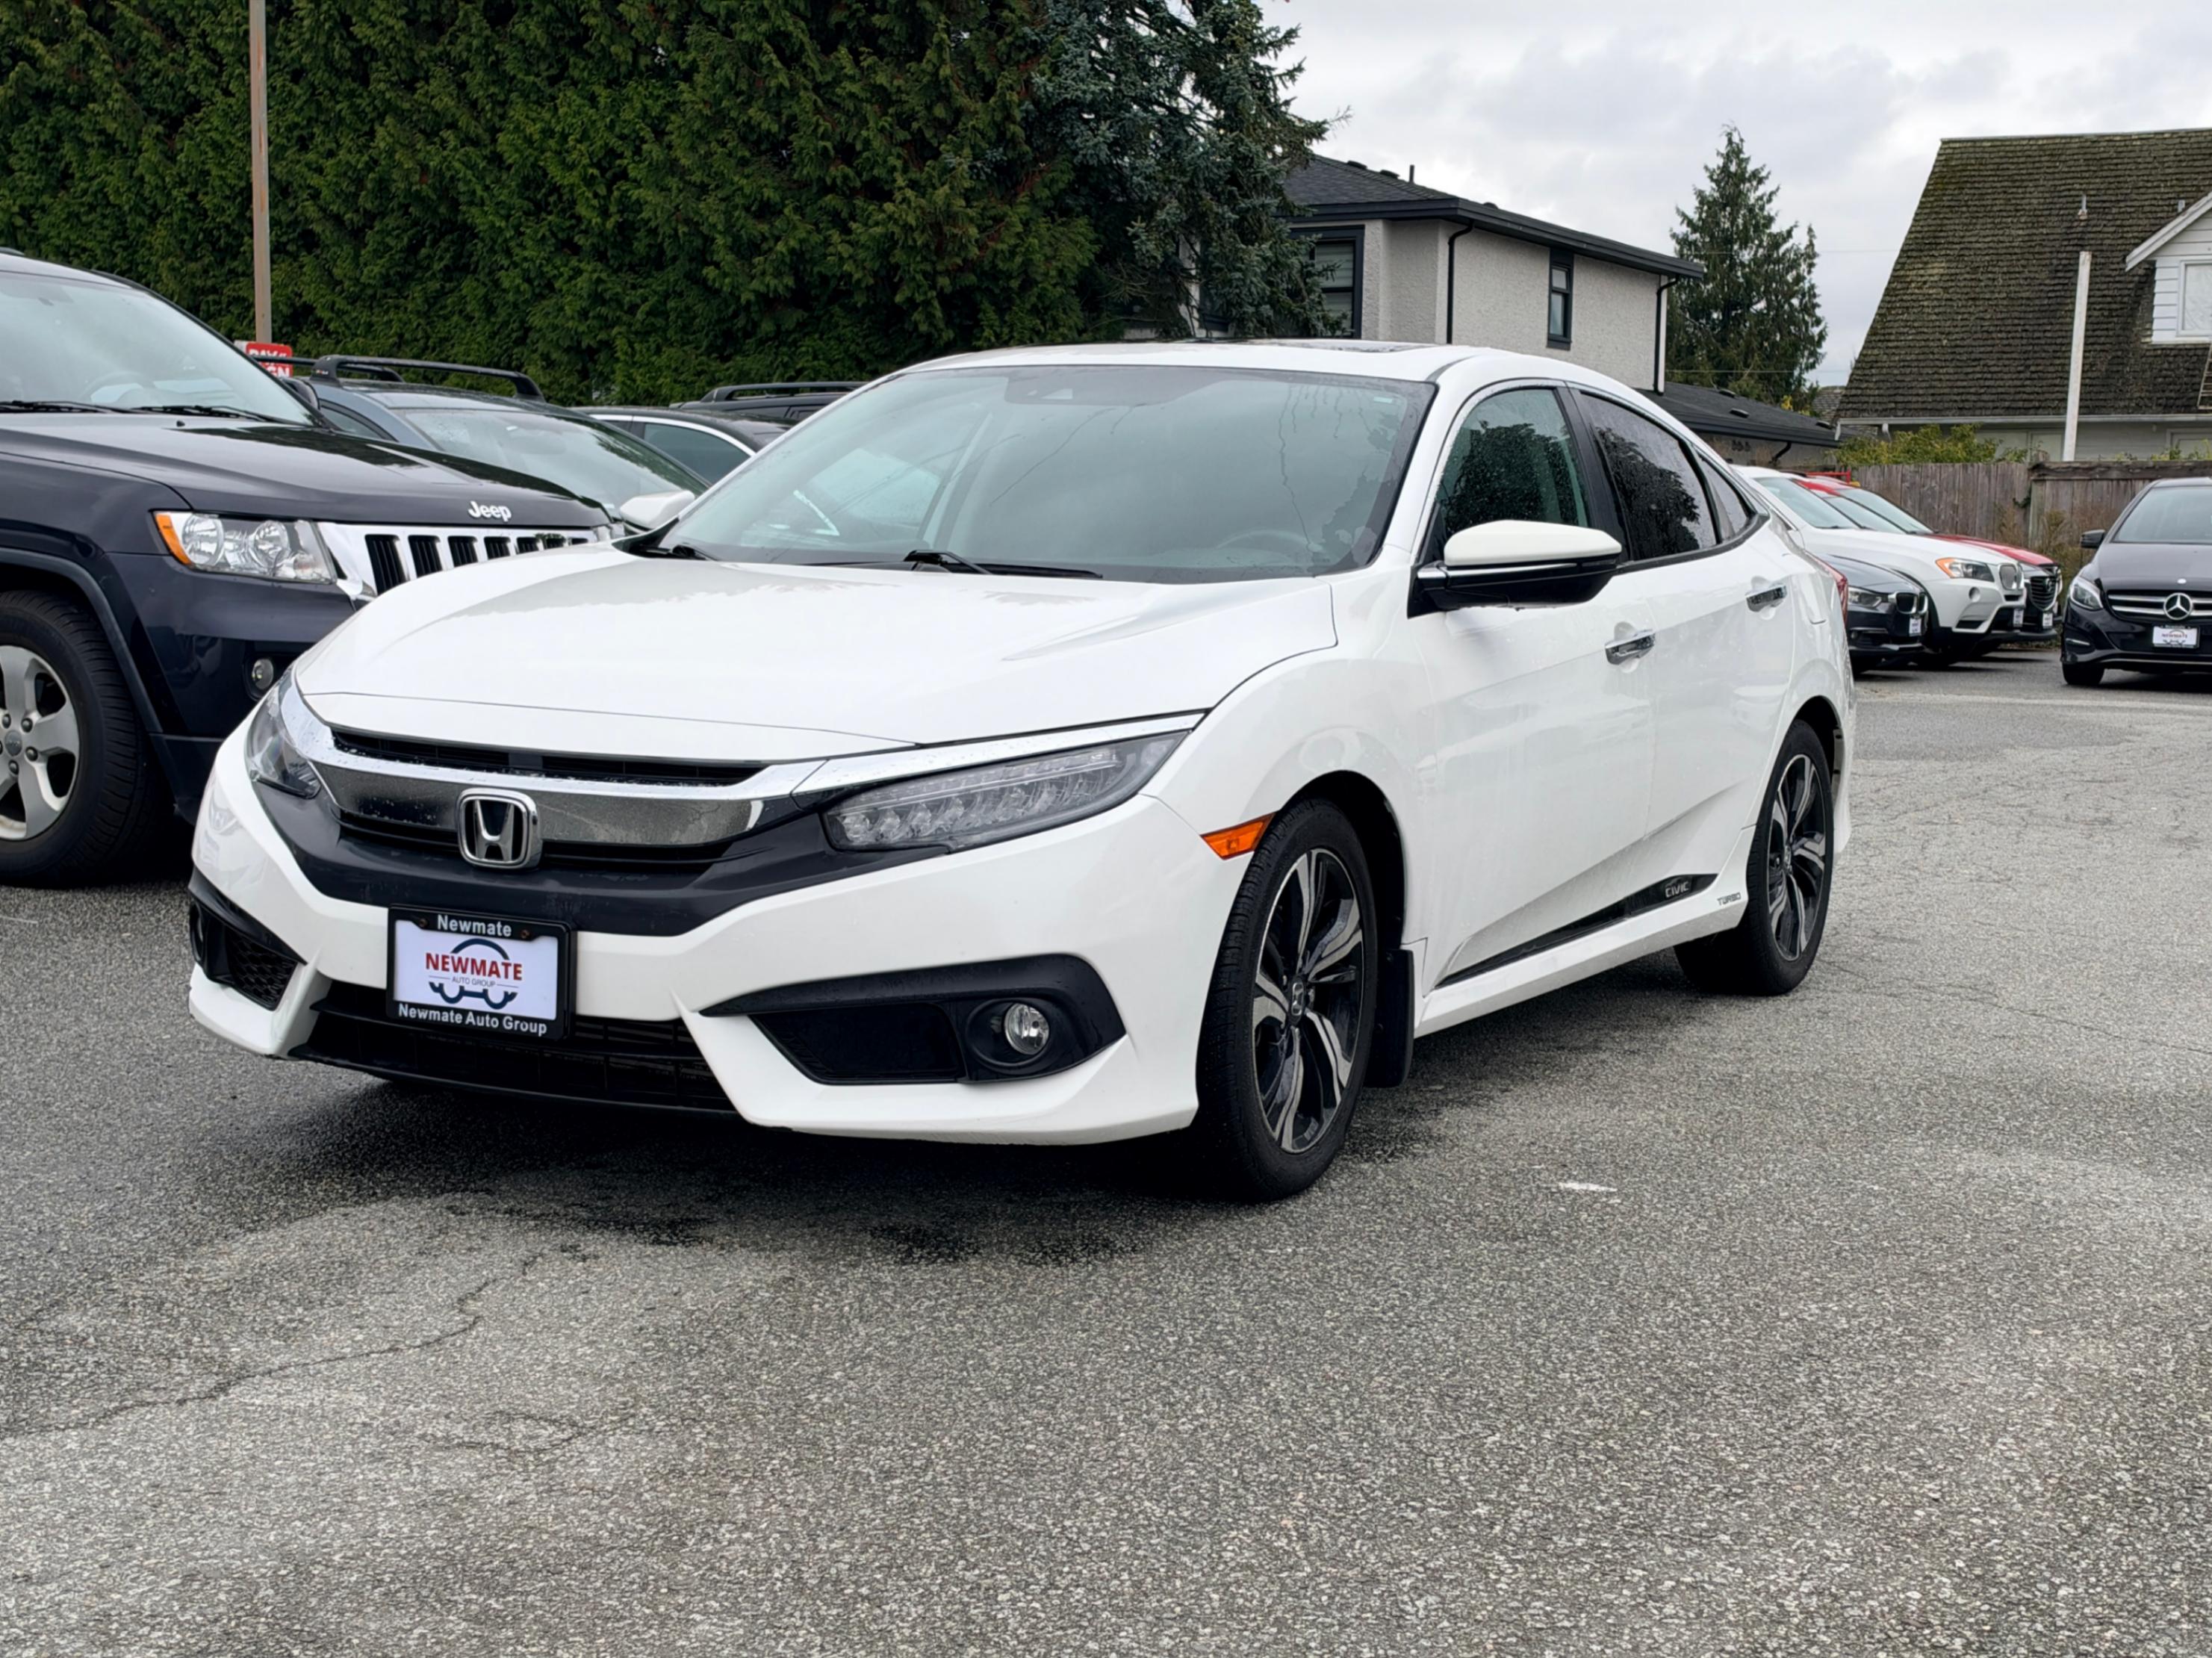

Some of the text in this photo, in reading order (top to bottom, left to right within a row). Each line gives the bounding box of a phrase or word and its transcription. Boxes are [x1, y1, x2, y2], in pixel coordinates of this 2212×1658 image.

[467, 500, 512, 522] Jeep
[1665, 881, 1690, 898] CIVIC
[1717, 892, 1742, 905] TURBO
[437, 914, 512, 937] Newmate
[426, 953, 523, 981] NEWMATE
[452, 976, 496, 987] AUTO GROUP
[398, 1003, 547, 1037] Newmate Auto Group
